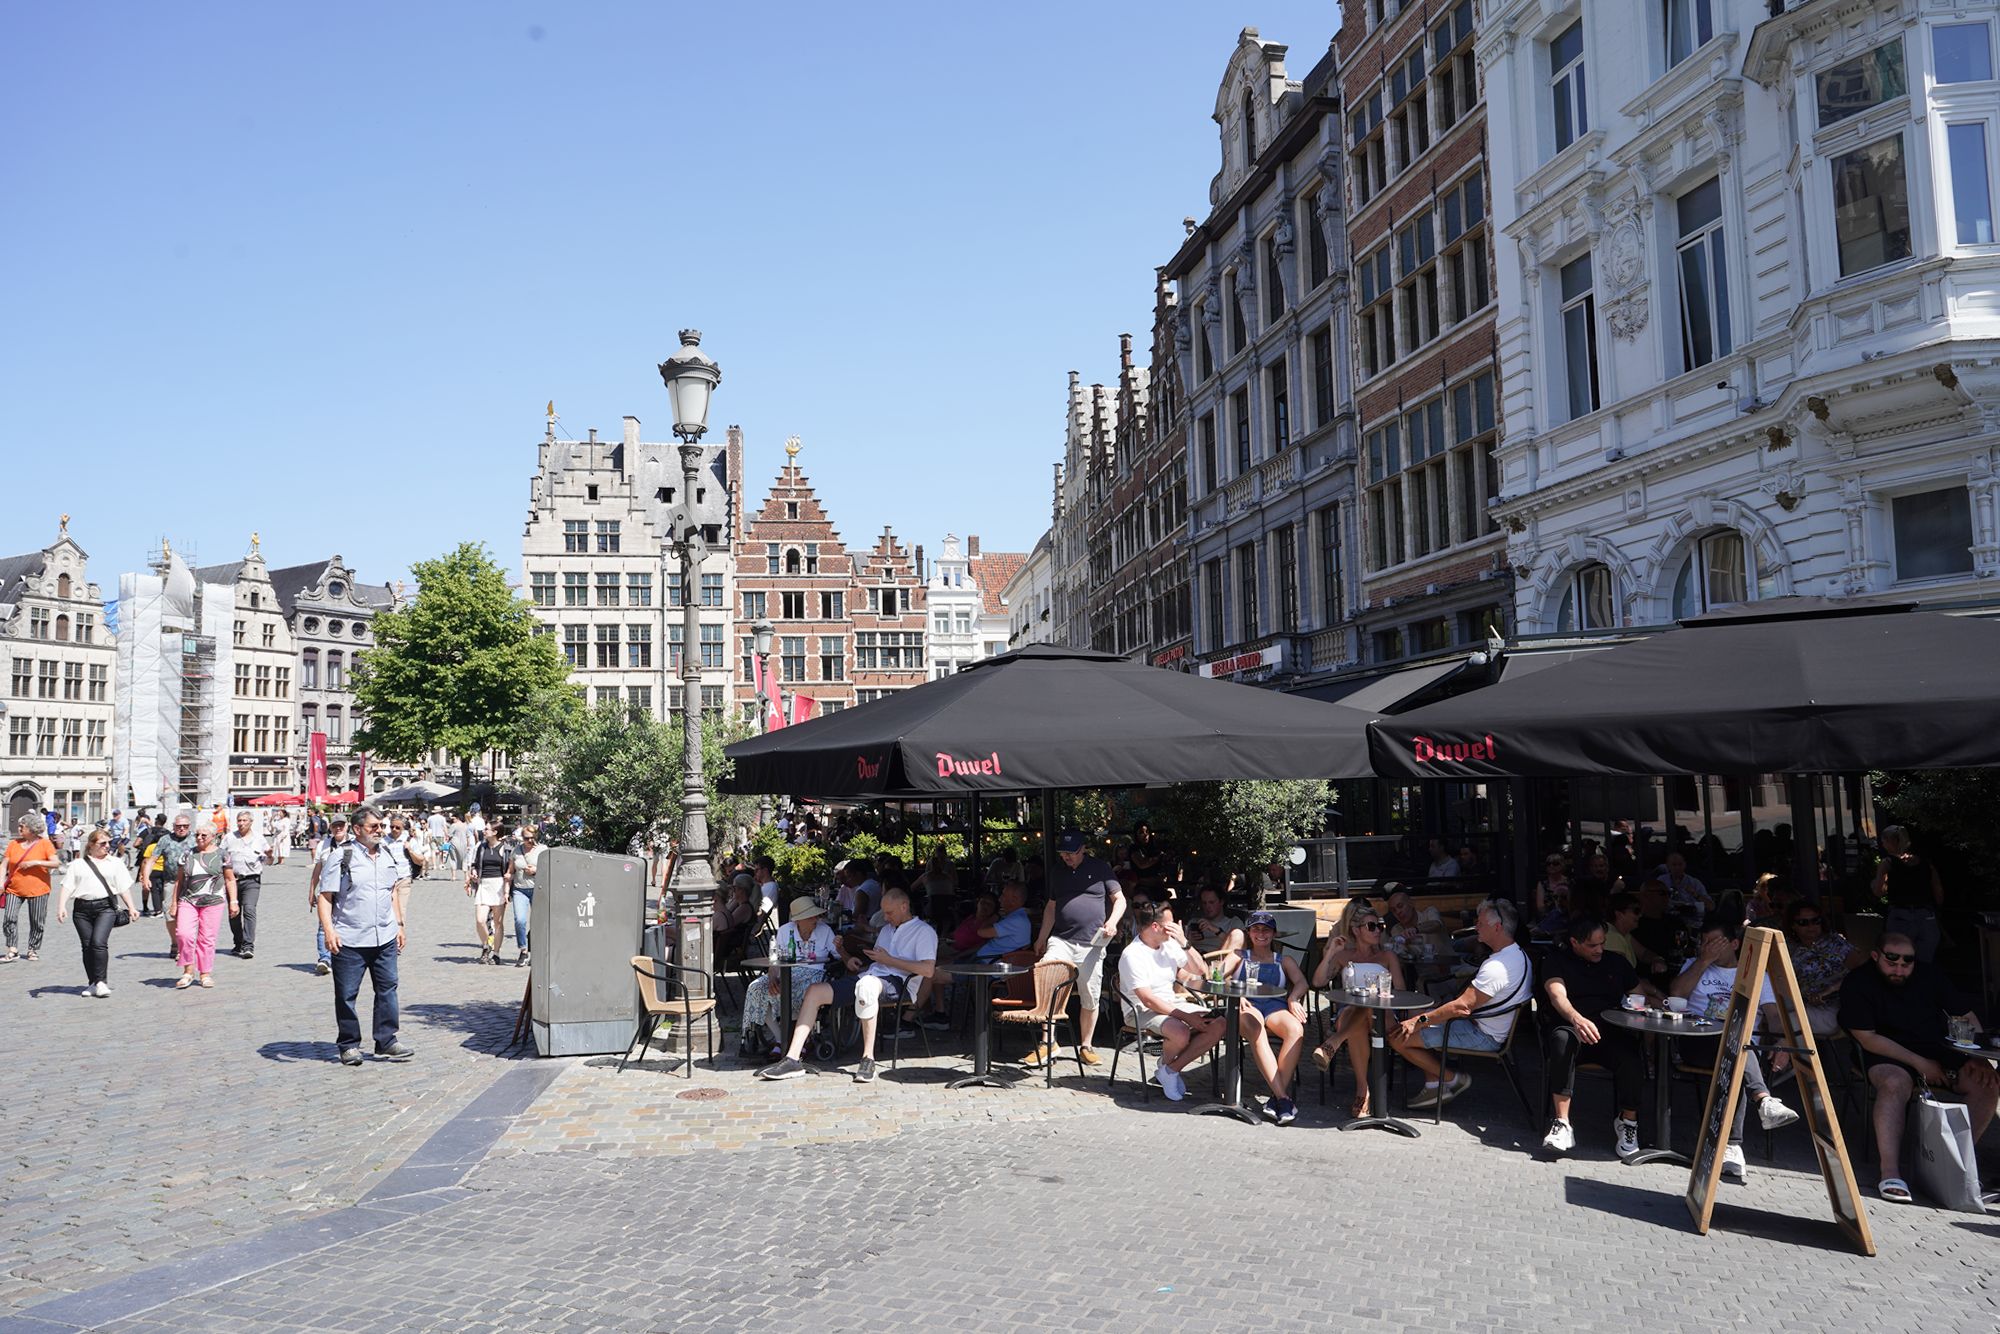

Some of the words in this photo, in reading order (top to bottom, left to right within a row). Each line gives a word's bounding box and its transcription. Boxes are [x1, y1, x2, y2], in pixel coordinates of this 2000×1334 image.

[1211, 658, 1235, 676] BELLA
[1236, 652, 1260, 670] PATIO
[768, 702, 779, 718] A
[1411, 734, 1496, 762] Duvel
[314, 760, 322, 769] A
[936, 751, 1001, 778] Duvel
